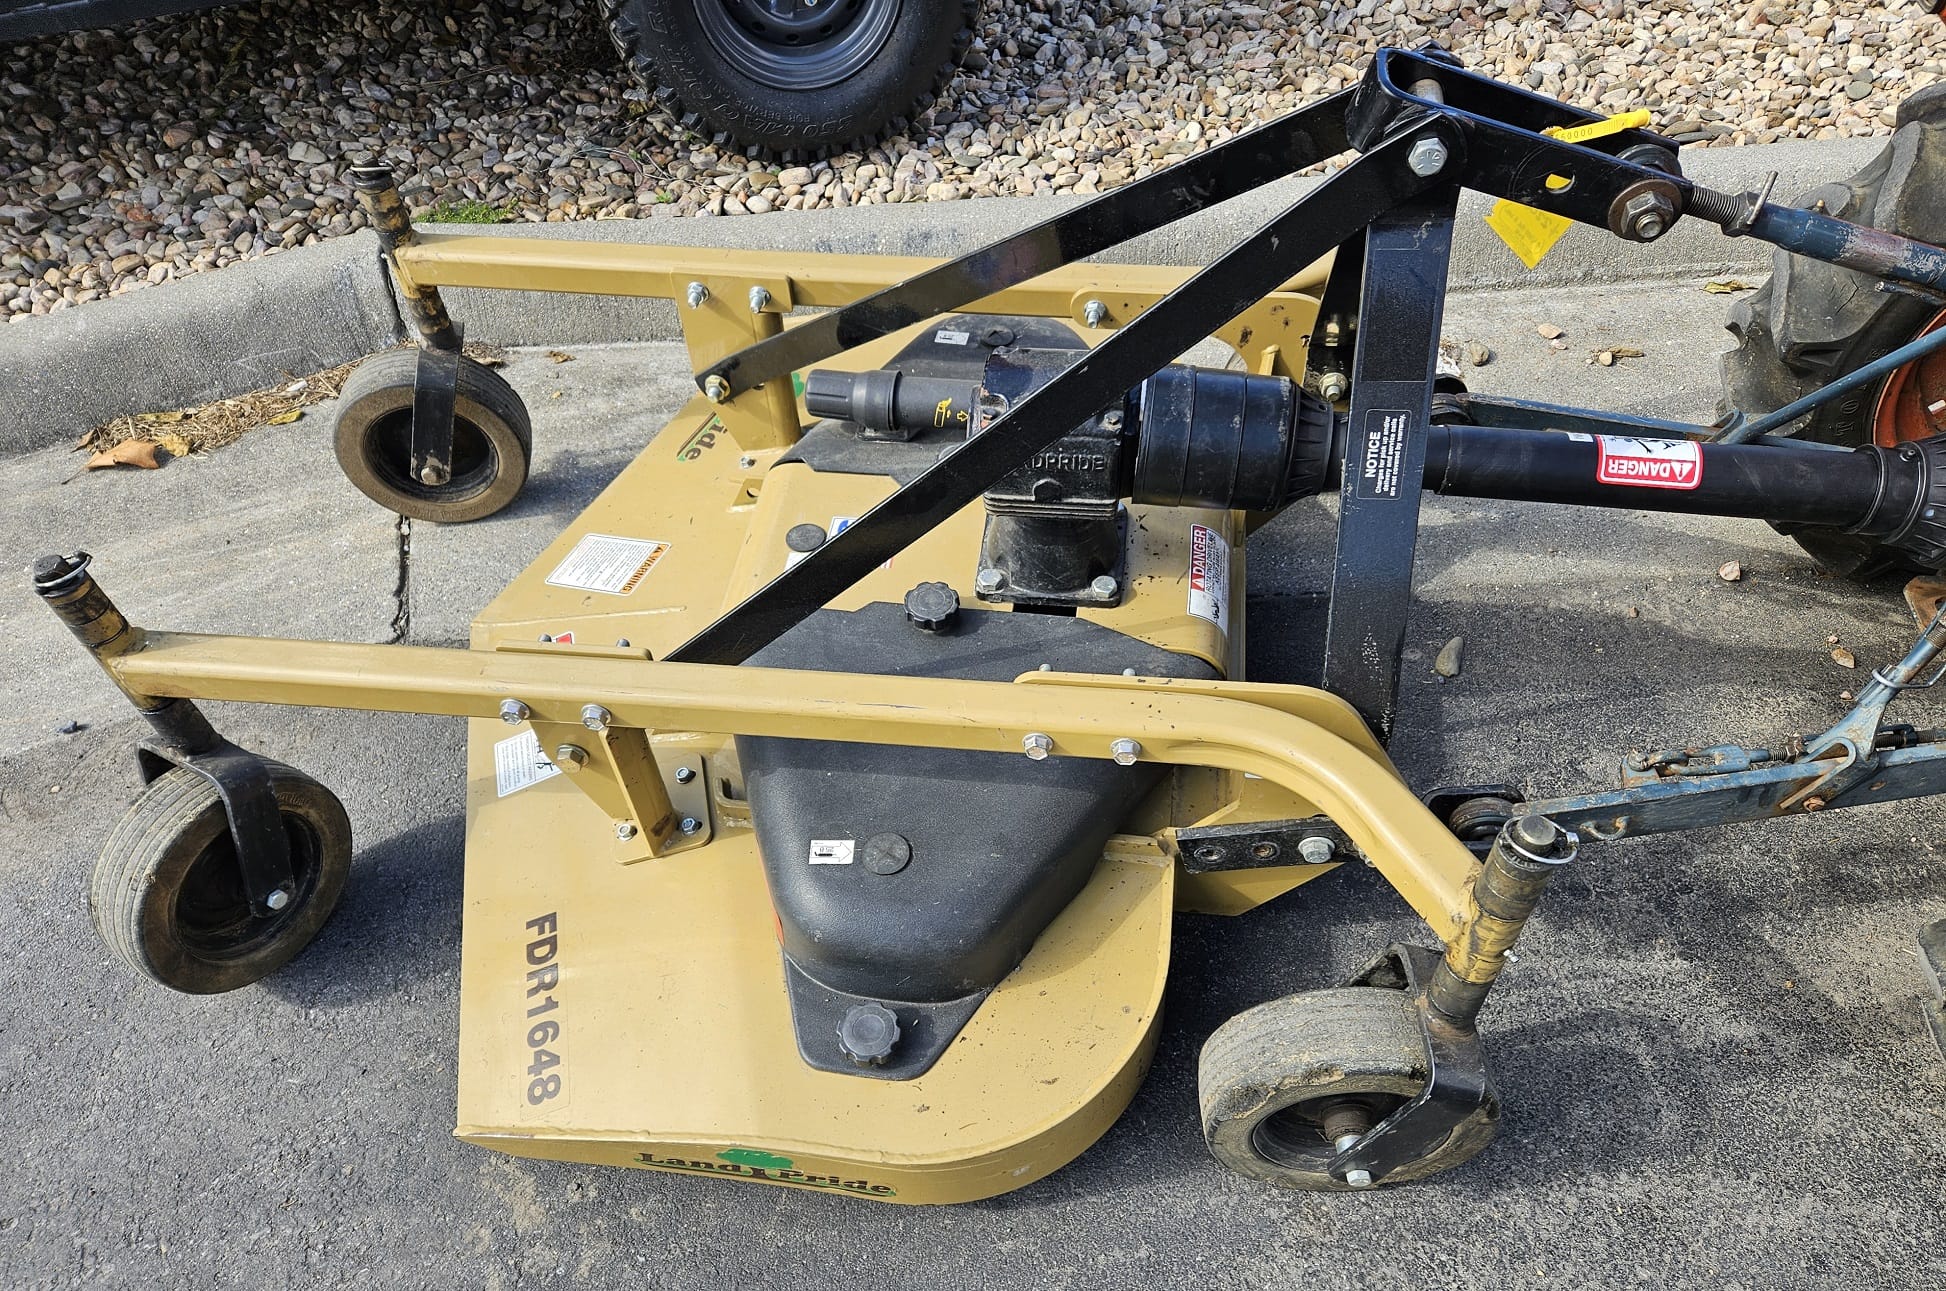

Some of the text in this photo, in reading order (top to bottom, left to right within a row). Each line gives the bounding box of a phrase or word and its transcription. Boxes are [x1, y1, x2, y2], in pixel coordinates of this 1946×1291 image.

[685, 424, 728, 460] ide
[1365, 432, 1381, 478] NOTICE
[1382, 436, 1389, 444] up
[1607, 458, 1671, 478] DANGER
[1193, 529, 1205, 576] DANGER
[622, 555, 656, 592] WARNING
[526, 911, 561, 1106] FDR1648
[640, 1152, 892, 1194] Land Pride
